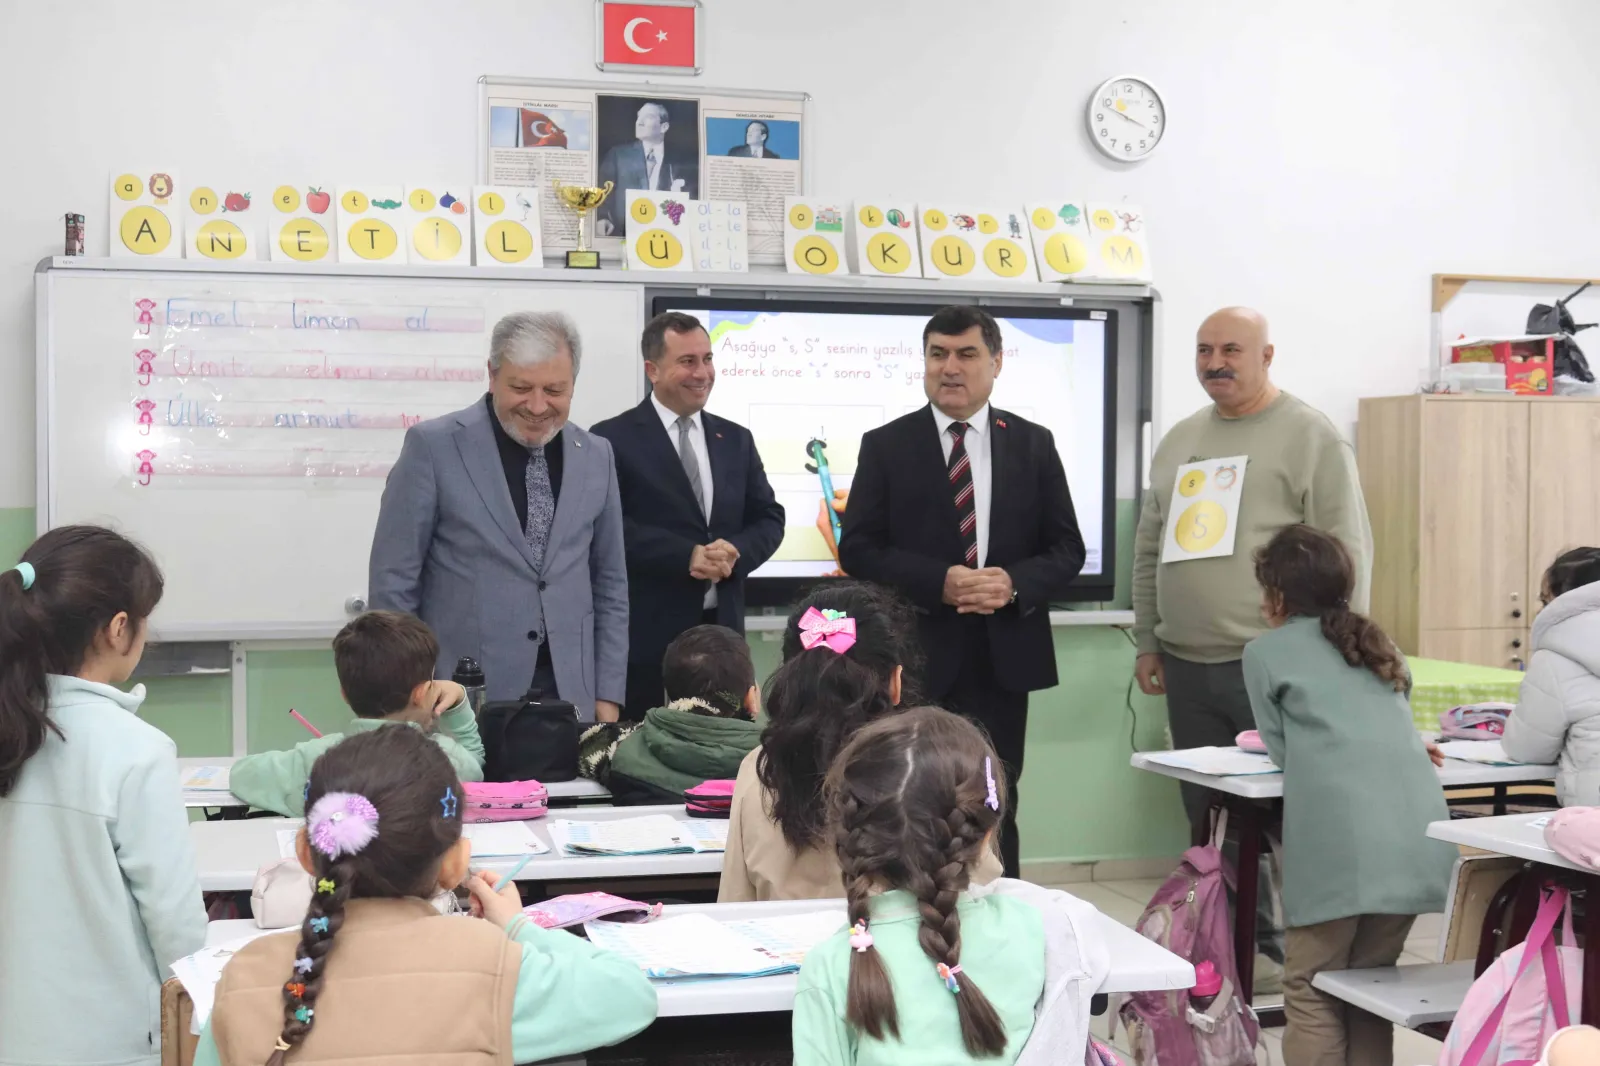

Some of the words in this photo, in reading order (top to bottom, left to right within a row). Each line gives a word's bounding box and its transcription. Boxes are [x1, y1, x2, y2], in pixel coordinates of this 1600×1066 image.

[1111, 87, 1118, 97] 11
[1123, 84, 1133, 93] 12
[1102, 98, 1112, 108] 10
[1148, 99, 1155, 109] 2
[1096, 113, 1104, 122] 9
[1152, 115, 1159, 124] 3
[1101, 128, 1109, 137] 8
[1148, 130, 1155, 138] 4
[1110, 138, 1118, 148] 7
[1124, 143, 1132, 152] 6
[1139, 139, 1146, 148] 5
[124, 183, 133, 192] a
[200, 197, 208, 206] n
[282, 195, 290, 204] e
[352, 195, 358, 207] t
[639, 204, 647, 216] ü
[797, 212, 805, 222] o
[867, 210, 874, 222] k
[931, 217, 939, 225] u
[1099, 216, 1110, 225] m
[983, 220, 989, 228] r
[134, 218, 157, 244] A
[210, 232, 232, 253] N
[296, 230, 313, 253] E
[363, 228, 380, 250] T
[501, 231, 518, 254] L
[804, 246, 828, 267] O
[881, 242, 899, 264] K
[943, 244, 963, 267] U
[998, 247, 1013, 269] R
[1110, 246, 1134, 264] M
[166, 297, 242, 327] Emel
[292, 300, 360, 330] limon
[721, 336, 777, 359] Aşağıya
[826, 343, 868, 354] sesinin
[873, 340, 913, 361] yazılış
[721, 362, 766, 377] ederek
[772, 364, 803, 378] önce
[834, 368, 871, 379] sonra
[1188, 479, 1195, 488] s
[1192, 513, 1208, 539] S
